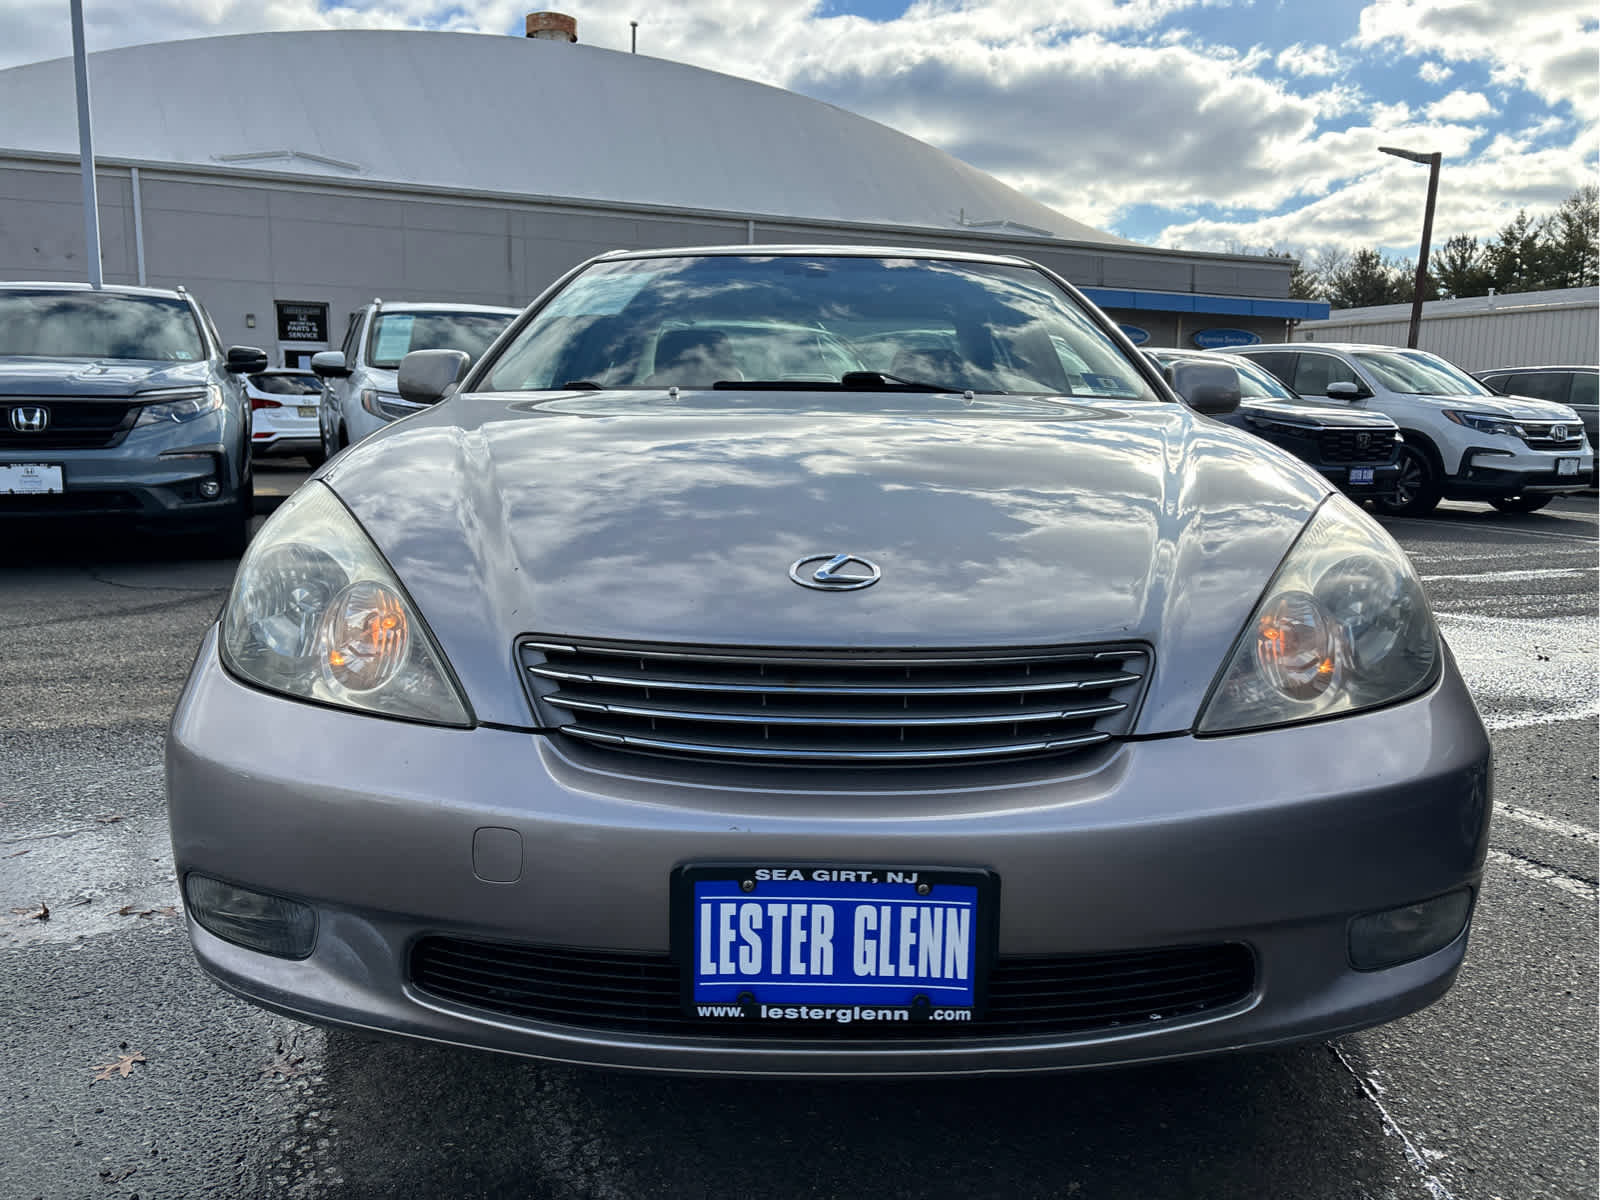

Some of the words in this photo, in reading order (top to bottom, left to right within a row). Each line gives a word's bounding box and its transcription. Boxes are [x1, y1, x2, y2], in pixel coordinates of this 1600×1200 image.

[755, 869, 804, 881] SEA
[812, 870, 878, 884] GIRT,
[887, 872, 918, 884] NJ
[700, 902, 835, 976] LESTER
[853, 904, 971, 980] GLENN
[697, 1005, 745, 1018] www.
[761, 1004, 909, 1024] lesterglenn
[929, 1009, 972, 1021] .com
